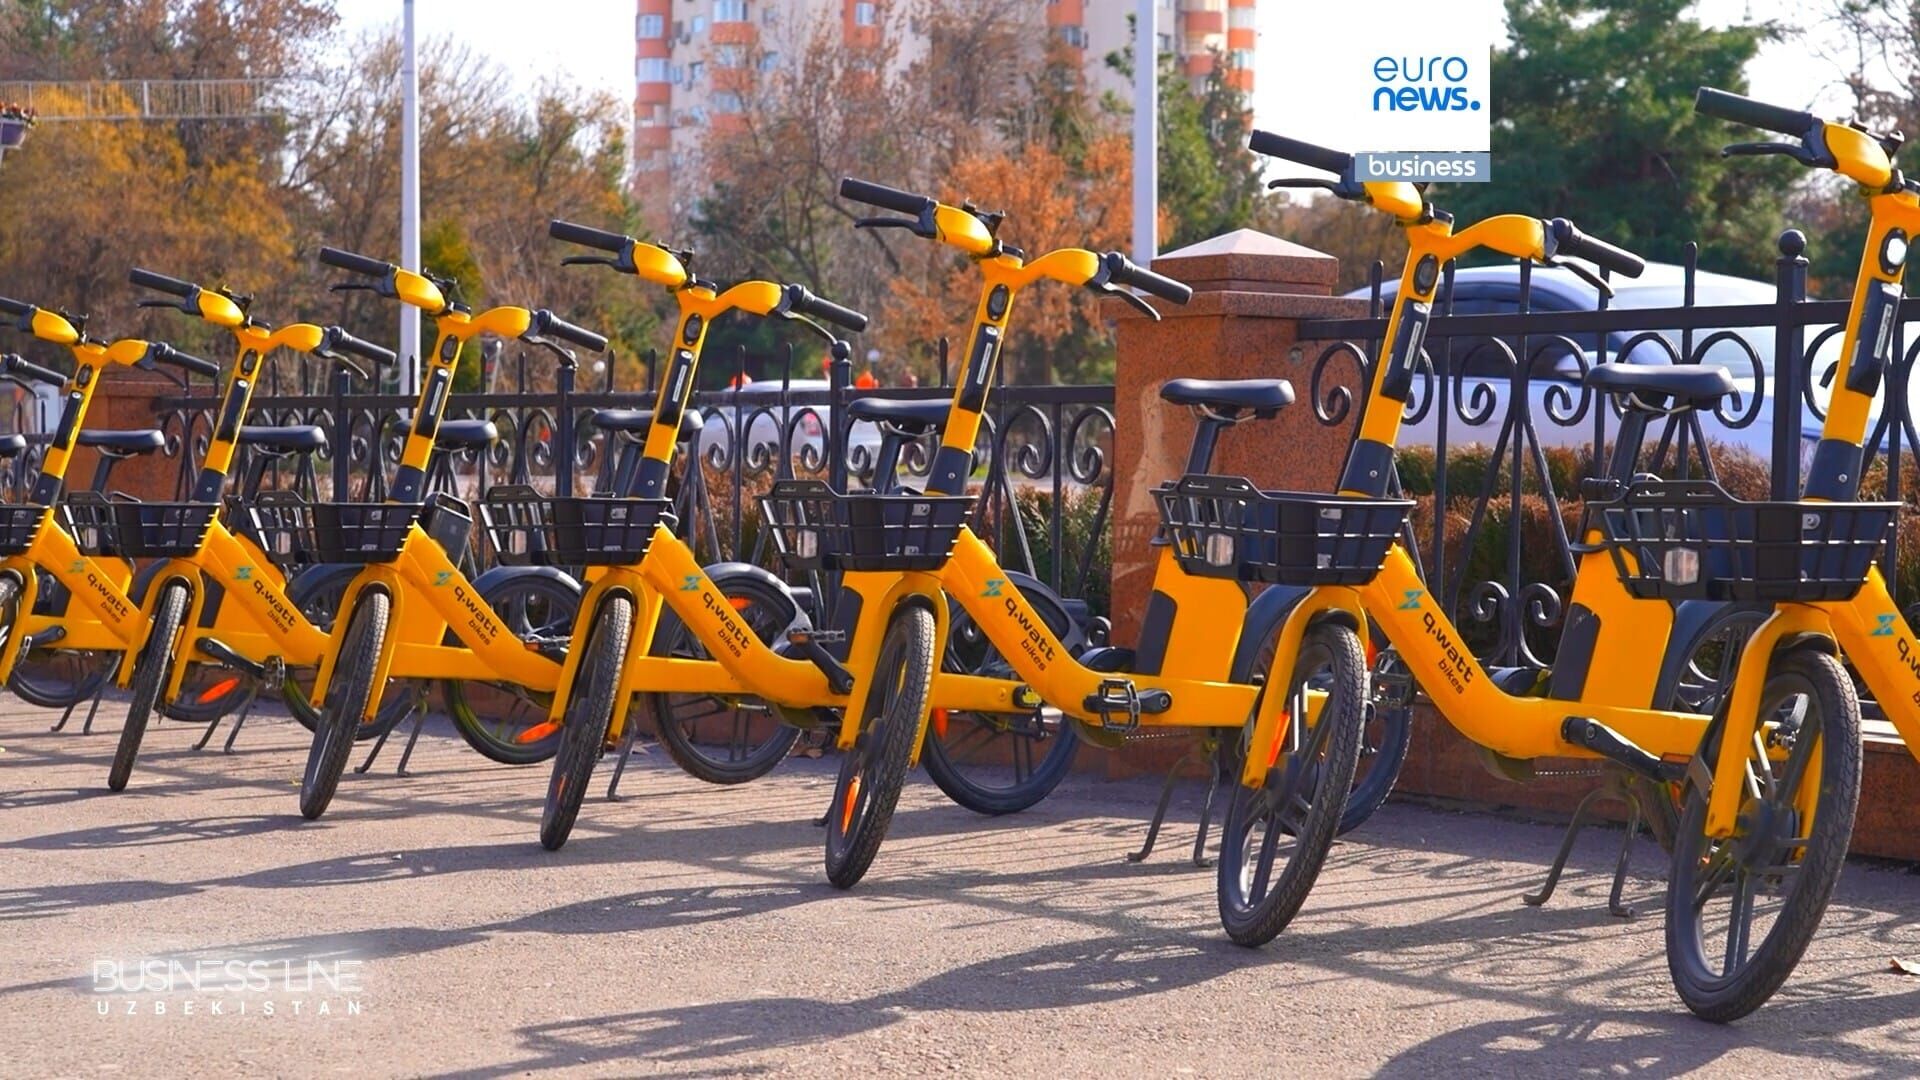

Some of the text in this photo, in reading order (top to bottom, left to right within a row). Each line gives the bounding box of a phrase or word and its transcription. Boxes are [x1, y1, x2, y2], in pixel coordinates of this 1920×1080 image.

[86, 572, 129, 617] q.watt
[100, 602, 121, 624] bikes
[253, 579, 297, 628] q.watt
[454, 586, 499, 638] q.watt
[268, 609, 289, 634] bikes
[468, 619, 491, 646] bikes
[703, 591, 750, 650] q.watt
[1004, 598, 1056, 661] q.watt
[717, 629, 741, 657] bikes
[1020, 639, 1047, 671] bikes
[1423, 612, 1474, 684] q.watt
[1437, 658, 1464, 694] bikes
